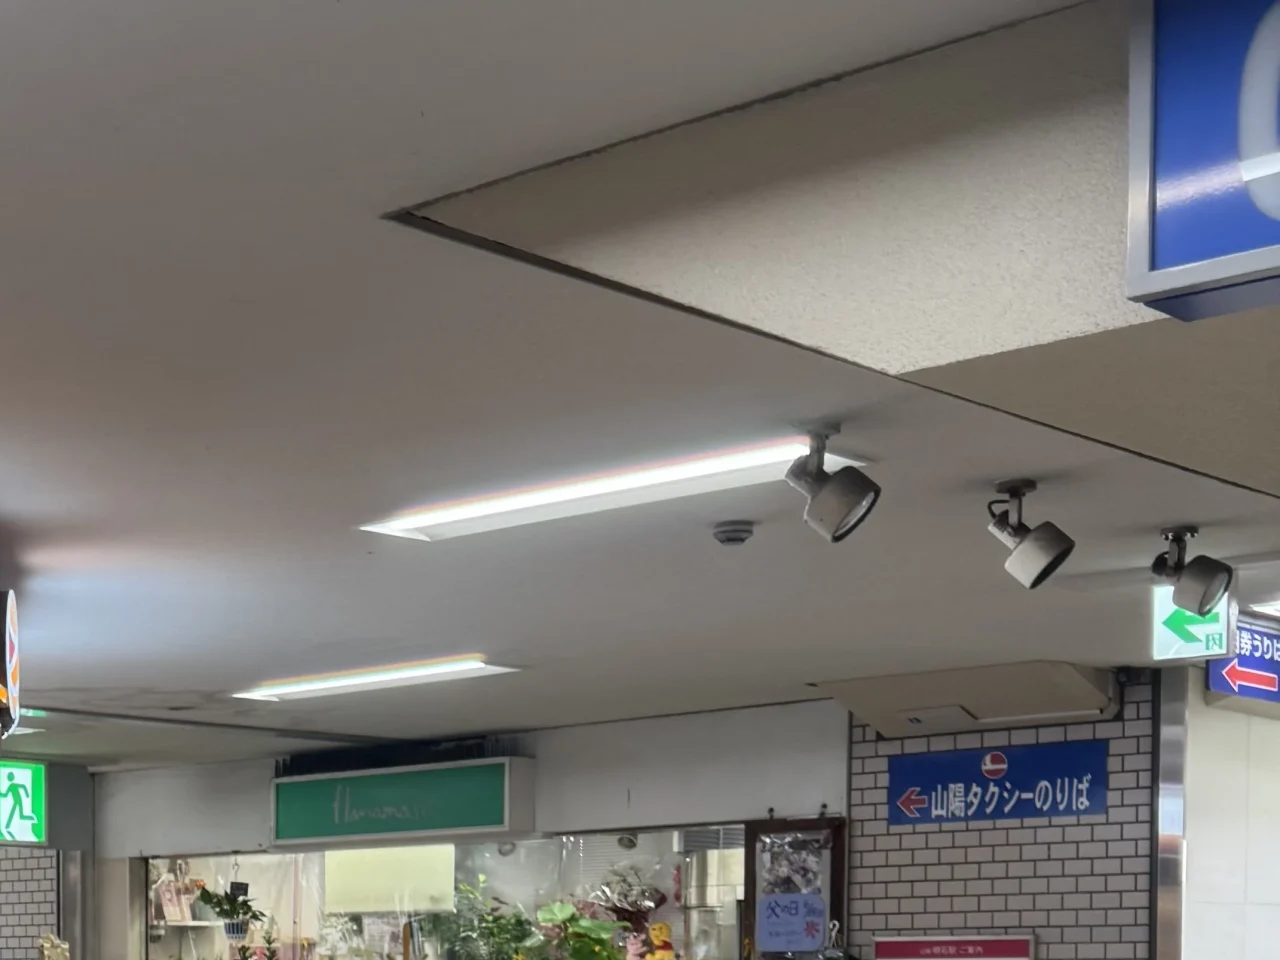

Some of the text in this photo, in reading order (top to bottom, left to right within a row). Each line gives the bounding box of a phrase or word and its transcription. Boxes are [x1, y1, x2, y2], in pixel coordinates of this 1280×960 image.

[931, 773, 1092, 819] 山陽タクシーのりば
